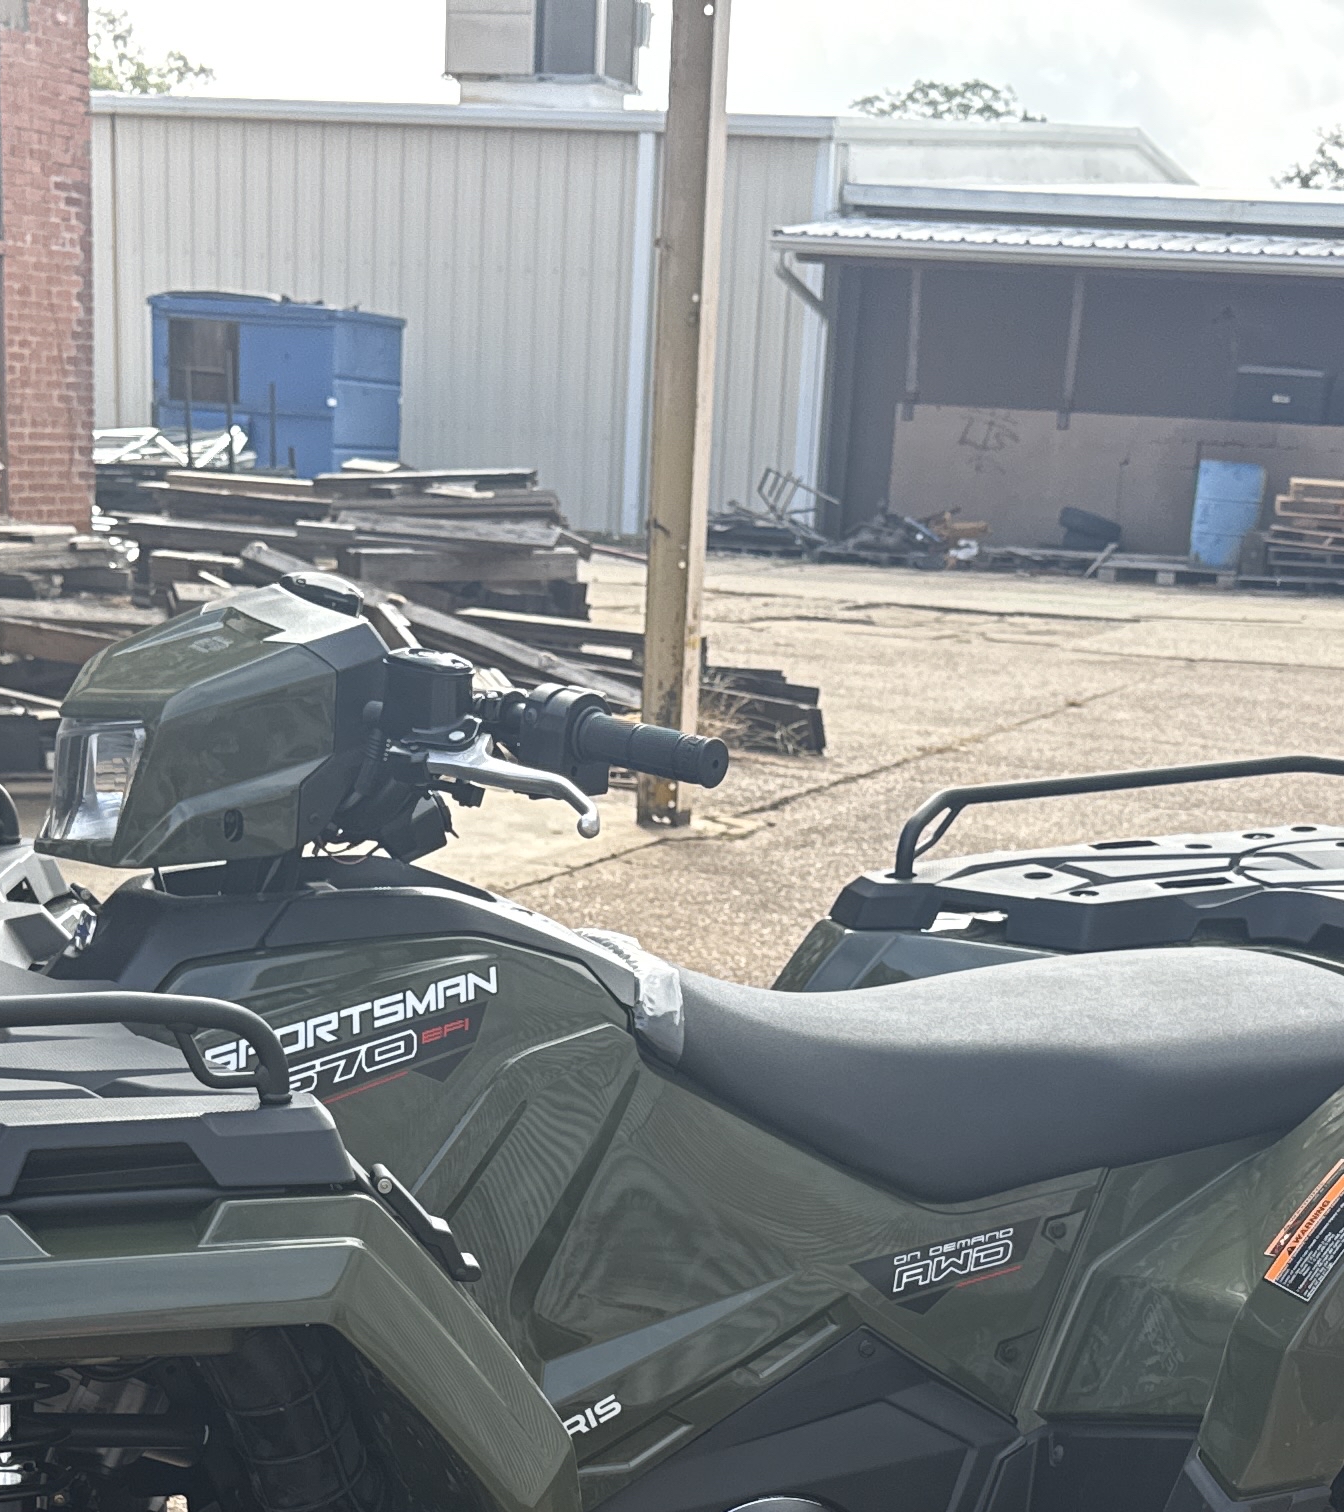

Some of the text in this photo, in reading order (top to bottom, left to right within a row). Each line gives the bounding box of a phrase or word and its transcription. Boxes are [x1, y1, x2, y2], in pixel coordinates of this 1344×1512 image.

[421, 1018, 470, 1045] EFI
[1294, 1200, 1331, 1246] WARNING
[892, 1239, 1013, 1293] AWD
[893, 1227, 1014, 1266] ON DEMAND
